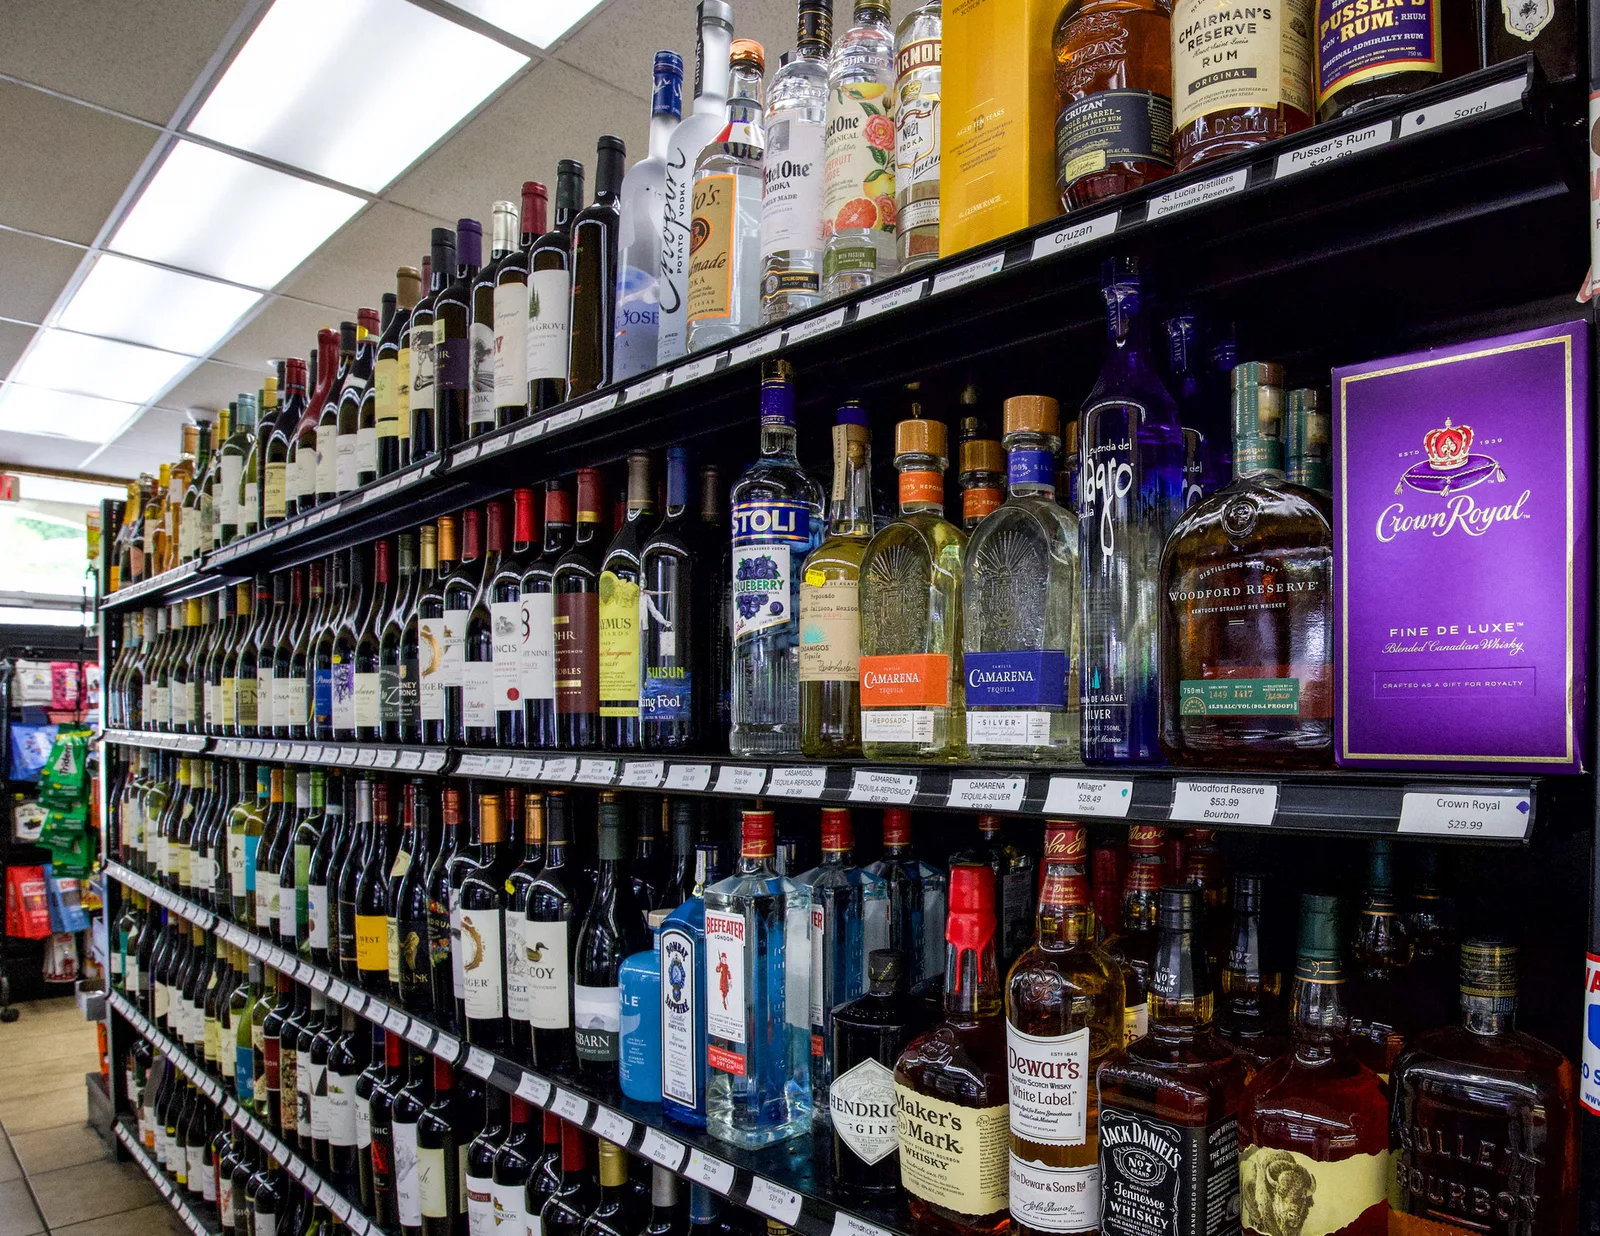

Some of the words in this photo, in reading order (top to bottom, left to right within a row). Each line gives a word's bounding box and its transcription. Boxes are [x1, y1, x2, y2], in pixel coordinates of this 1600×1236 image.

[1179, 8, 1272, 44] CHAIRMAN'S
[1340, 10, 1393, 42] RUM
[1187, 23, 1257, 52] RESERVE
[1202, 50, 1238, 68] RUM
[1323, 48, 1351, 71] ORIGINAL
[1353, 34, 1402, 51] ADMIRALTY
[1195, 71, 1247, 89] ORIGINAL
[1065, 99, 1103, 122] CRUZAN
[1082, 109, 1115, 121] BARREL
[1453, 101, 1487, 119] Sorel
[1292, 139, 1343, 162] Pusser's
[1346, 128, 1376, 145] Rum
[777, 194, 797, 202] MADE
[1161, 193, 1172, 203] St.
[1174, 186, 1196, 200] Lucia
[1197, 175, 1234, 193] Distillers
[1157, 196, 1201, 215] Chairmans
[1202, 185, 1235, 201] Reserve
[1054, 225, 1093, 245] Cruzan
[1118, 438, 1132, 451] del
[1398, 450, 1420, 458] ESTD
[1479, 438, 1503, 446] 1939
[732, 509, 796, 535] STOLI
[1375, 502, 1448, 543] Crown
[1168, 586, 1241, 602] WOODFORD
[1246, 581, 1316, 595] RESERVE
[1390, 628, 1428, 638] FINE
[1437, 626, 1459, 635] DE
[1381, 641, 1426, 654] Blended
[1428, 640, 1479, 652] Canadian
[1480, 636, 1525, 656] Whisky
[864, 672, 920, 689] CAMARENA
[969, 669, 1034, 688] CAMARENA
[657, 695, 681, 707] Fool
[1100, 693, 1124, 702] AGAVE
[982, 719, 1016, 727] SILVER
[774, 779, 822, 787] TEQUILA-REPOSADO
[870, 775, 901, 784] CAMARENA
[969, 782, 1005, 790] CAMARENA
[856, 784, 910, 795] TEQUILA-REPOSADO
[960, 792, 1011, 801] TEQUILA-SILVER
[1188, 784, 1228, 794] Woodford
[1230, 785, 1265, 795] Reserve
[1078, 794, 1102, 804] $28.49
[1209, 798, 1239, 807] $53.99
[1437, 799, 1469, 809] Crown
[1472, 800, 1500, 811] Royal
[1204, 810, 1240, 820] Bourbon
[1447, 820, 1483, 830] $29.99
[706, 916, 744, 941] BEEFEATER
[665, 941, 688, 962] BOMBAY
[664, 993, 690, 1014] SAPPHIRE
[668, 1022, 676, 1030] DRY
[677, 1025, 687, 1033] GIN
[1009, 1045, 1080, 1080] Dewar's
[1027, 1079, 1049, 1089] SCOTCH
[895, 1090, 962, 1131] Maker's
[856, 1124, 888, 1134] GIN
[908, 1120, 963, 1154] Mark
[1209, 1129, 1221, 1144] OUR
[1101, 1125, 1131, 1147] JACK
[1132, 1122, 1182, 1171] DANIEL'S
[904, 1145, 949, 1171] WHISKY
[1130, 1168, 1150, 1178] BRAND
[1021, 1174, 1045, 1190] Dewar
[1046, 1183, 1052, 1191] &
[1053, 1182, 1075, 1192] Sons
[1077, 1181, 1086, 1192] Ltd
[1129, 1184, 1150, 1195] QUALITY
[1114, 1181, 1165, 1211] Tennessee
[1110, 1200, 1169, 1230] WHISKEY
[1118, 1197, 1138, 1208] SOUR
[1141, 1205, 1161, 1216] MASH
